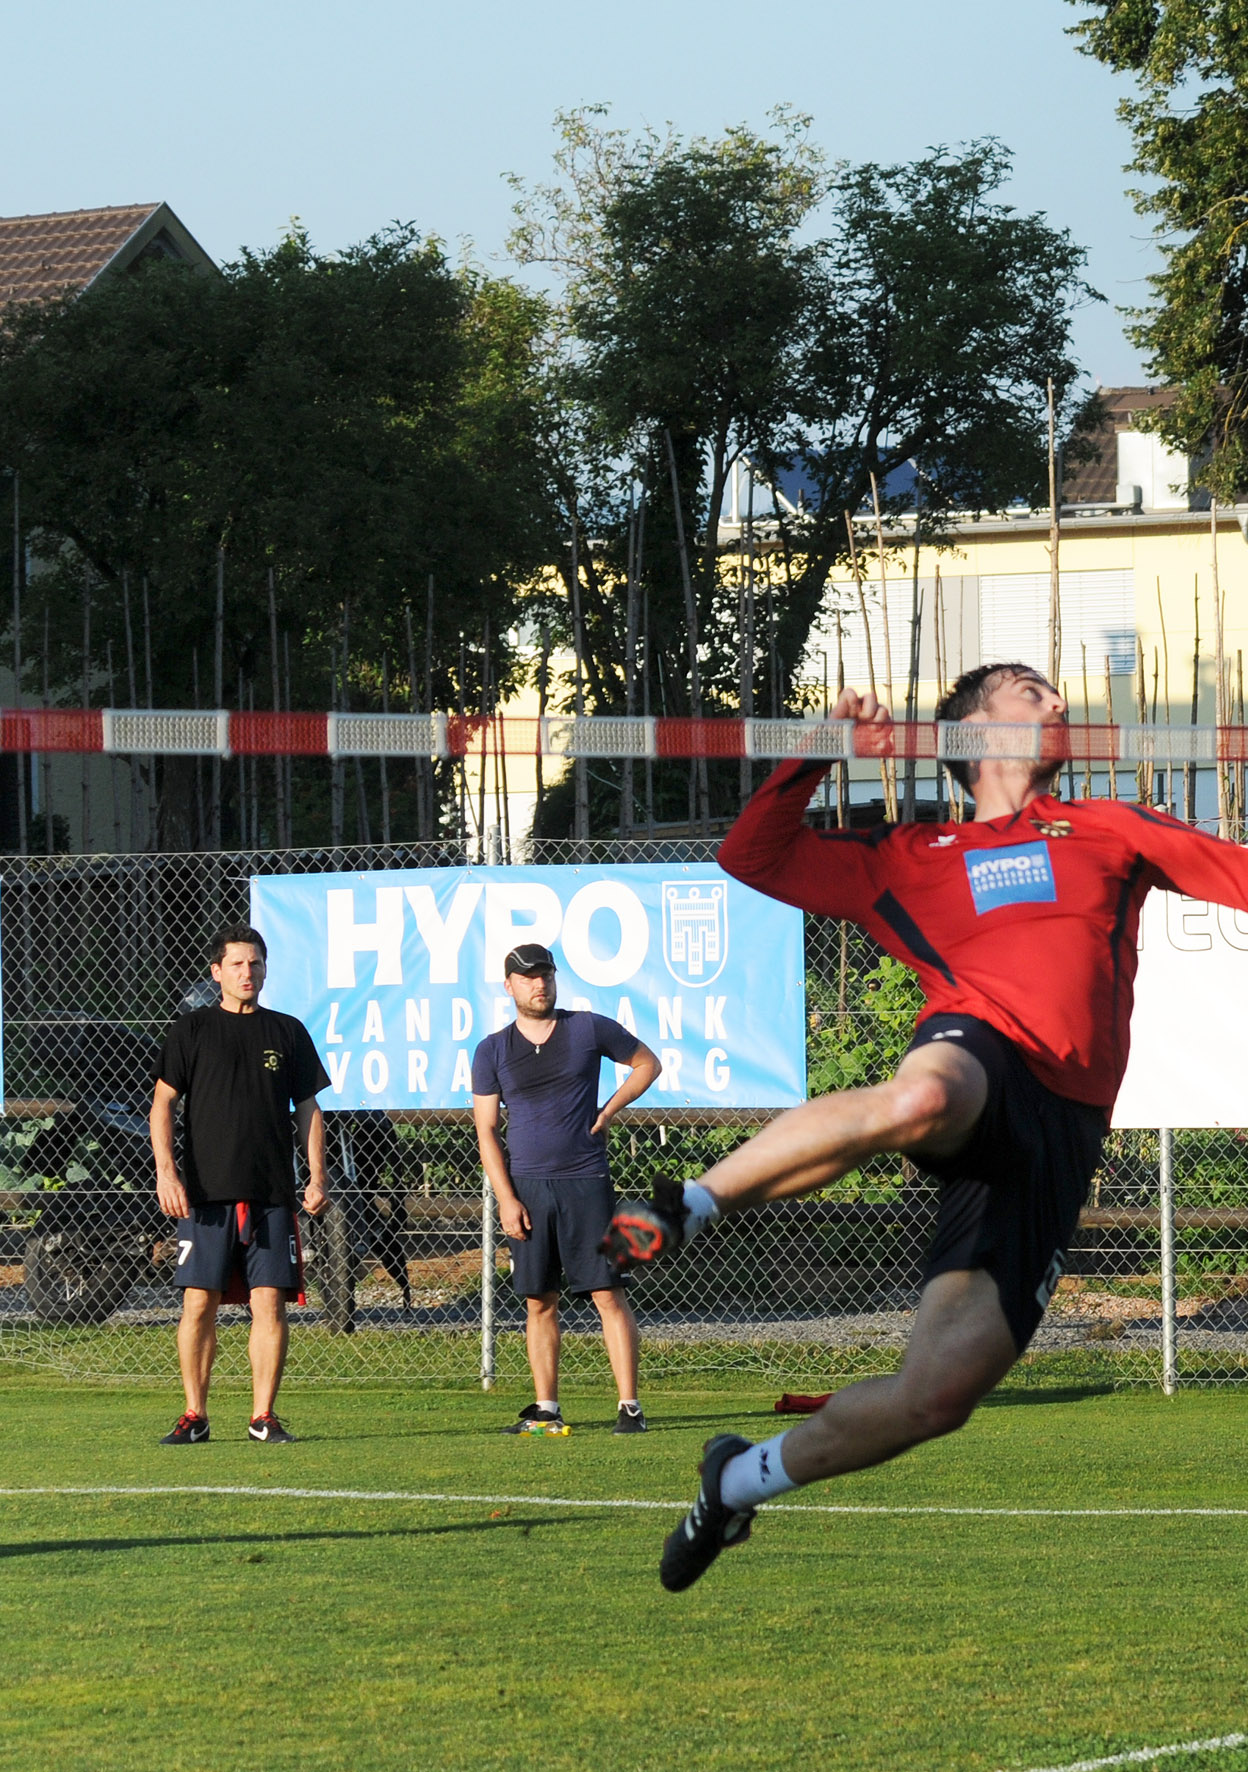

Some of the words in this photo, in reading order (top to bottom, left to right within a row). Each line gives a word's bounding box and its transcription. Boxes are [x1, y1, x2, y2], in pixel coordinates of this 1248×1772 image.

[971, 856, 1031, 878] HYPO
[327, 880, 650, 989] HYPO
[326, 996, 730, 1044] LANDEANK
[326, 1046, 731, 1094] VORARG
[178, 1240, 193, 1266] 7
